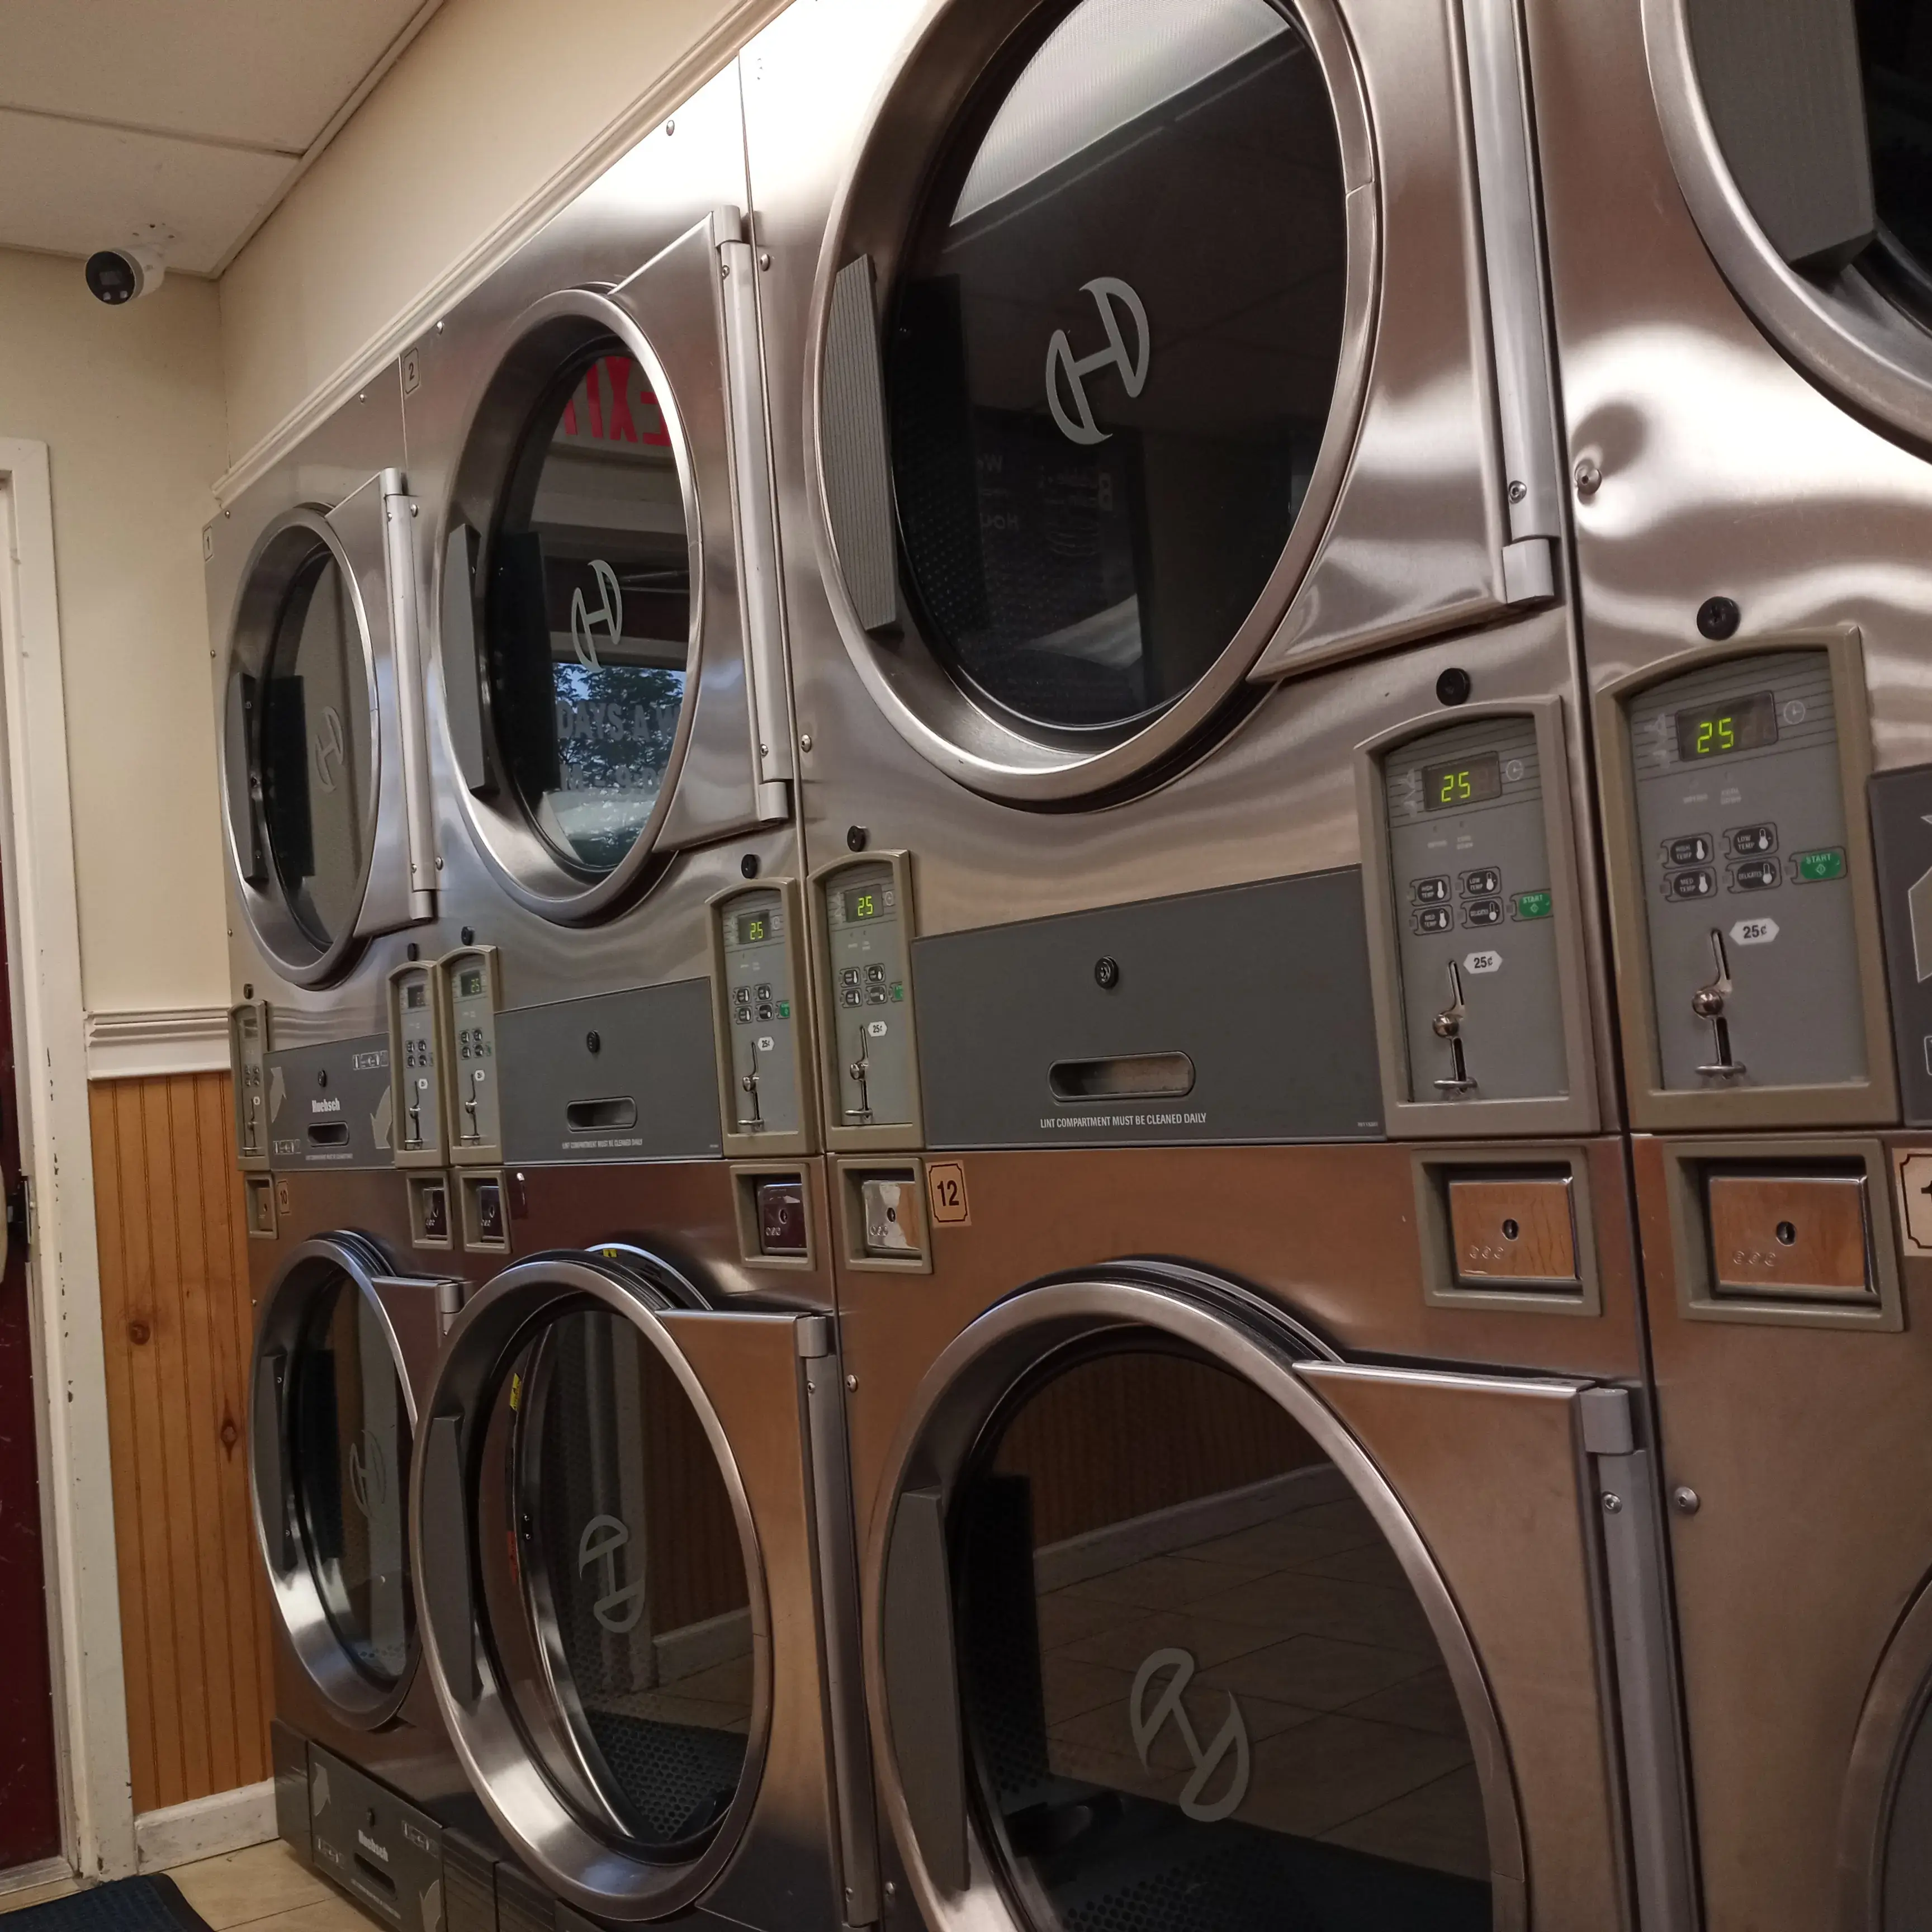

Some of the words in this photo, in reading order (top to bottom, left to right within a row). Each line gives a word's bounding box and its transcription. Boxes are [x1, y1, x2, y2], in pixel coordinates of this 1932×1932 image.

[408, 362, 415, 382] 2
[1697, 718, 1734, 752] 25
[1441, 771, 1471, 802] 25
[1737, 834, 1751, 842] LOW
[1737, 841, 1755, 850] TEMP
[1806, 853, 1832, 864] START
[857, 896, 874, 916] 25
[1522, 894, 1543, 904] START
[750, 921, 764, 940] 25
[1742, 925, 1767, 939] 25¢
[1474, 956, 1493, 969] 25¢
[312, 1097, 340, 1113] Huebsch
[1040, 1119, 1055, 1128] LINT
[1057, 1116, 1111, 1128] COMPARTMENT
[1112, 1116, 1134, 1125] MUST
[1135, 1115, 1145, 1125] BE
[1147, 1114, 1182, 1125] CLEANED
[1183, 1113, 1207, 1124] DAILY
[280, 1190, 288, 1205] 10
[936, 1180, 960, 1206] 12
